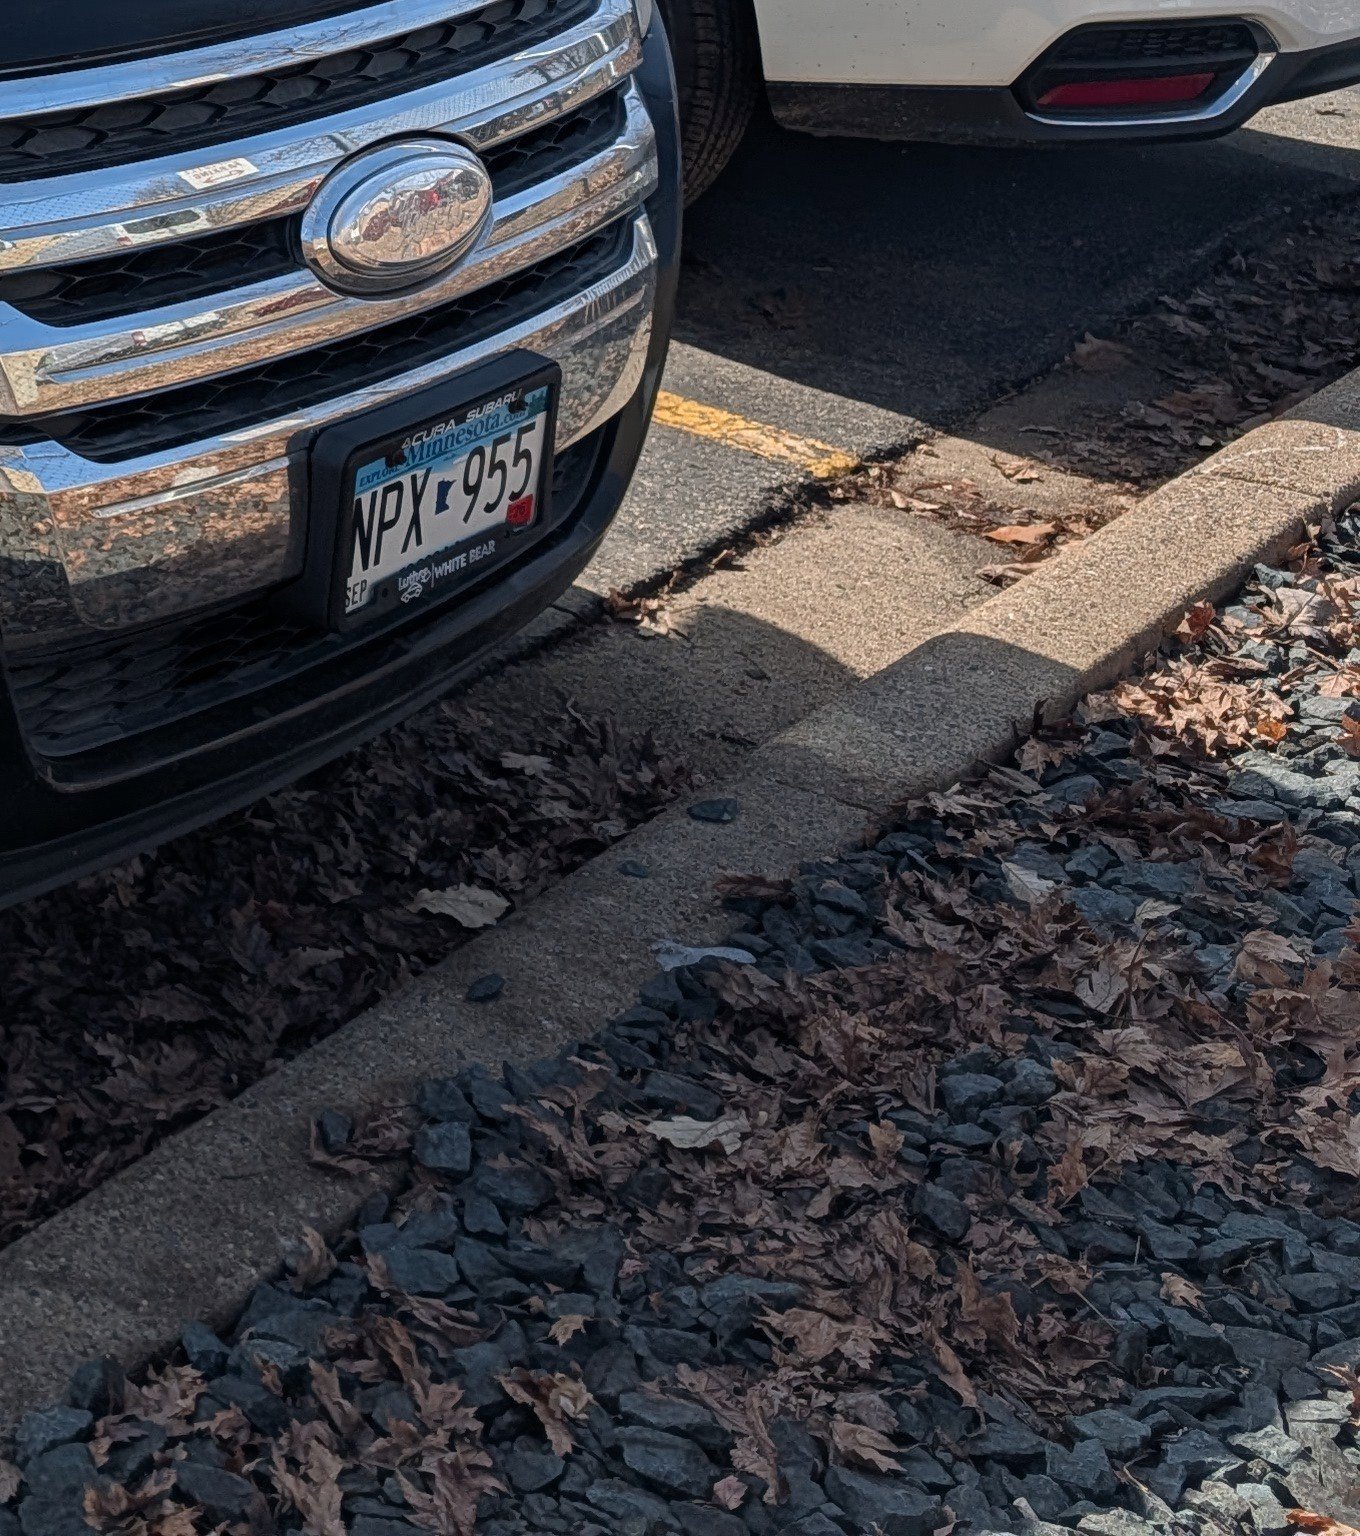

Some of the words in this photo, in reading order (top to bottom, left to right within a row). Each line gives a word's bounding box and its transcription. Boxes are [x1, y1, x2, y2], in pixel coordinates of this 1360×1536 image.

[401, 418, 456, 449] ACURA
[465, 388, 522, 423] SUBARU
[350, 466, 432, 577] NPX
[462, 421, 537, 524] 955
[434, 552, 467, 579] WHITE
[469, 539, 495, 564] BEAR
[345, 578, 367, 607] SEP
